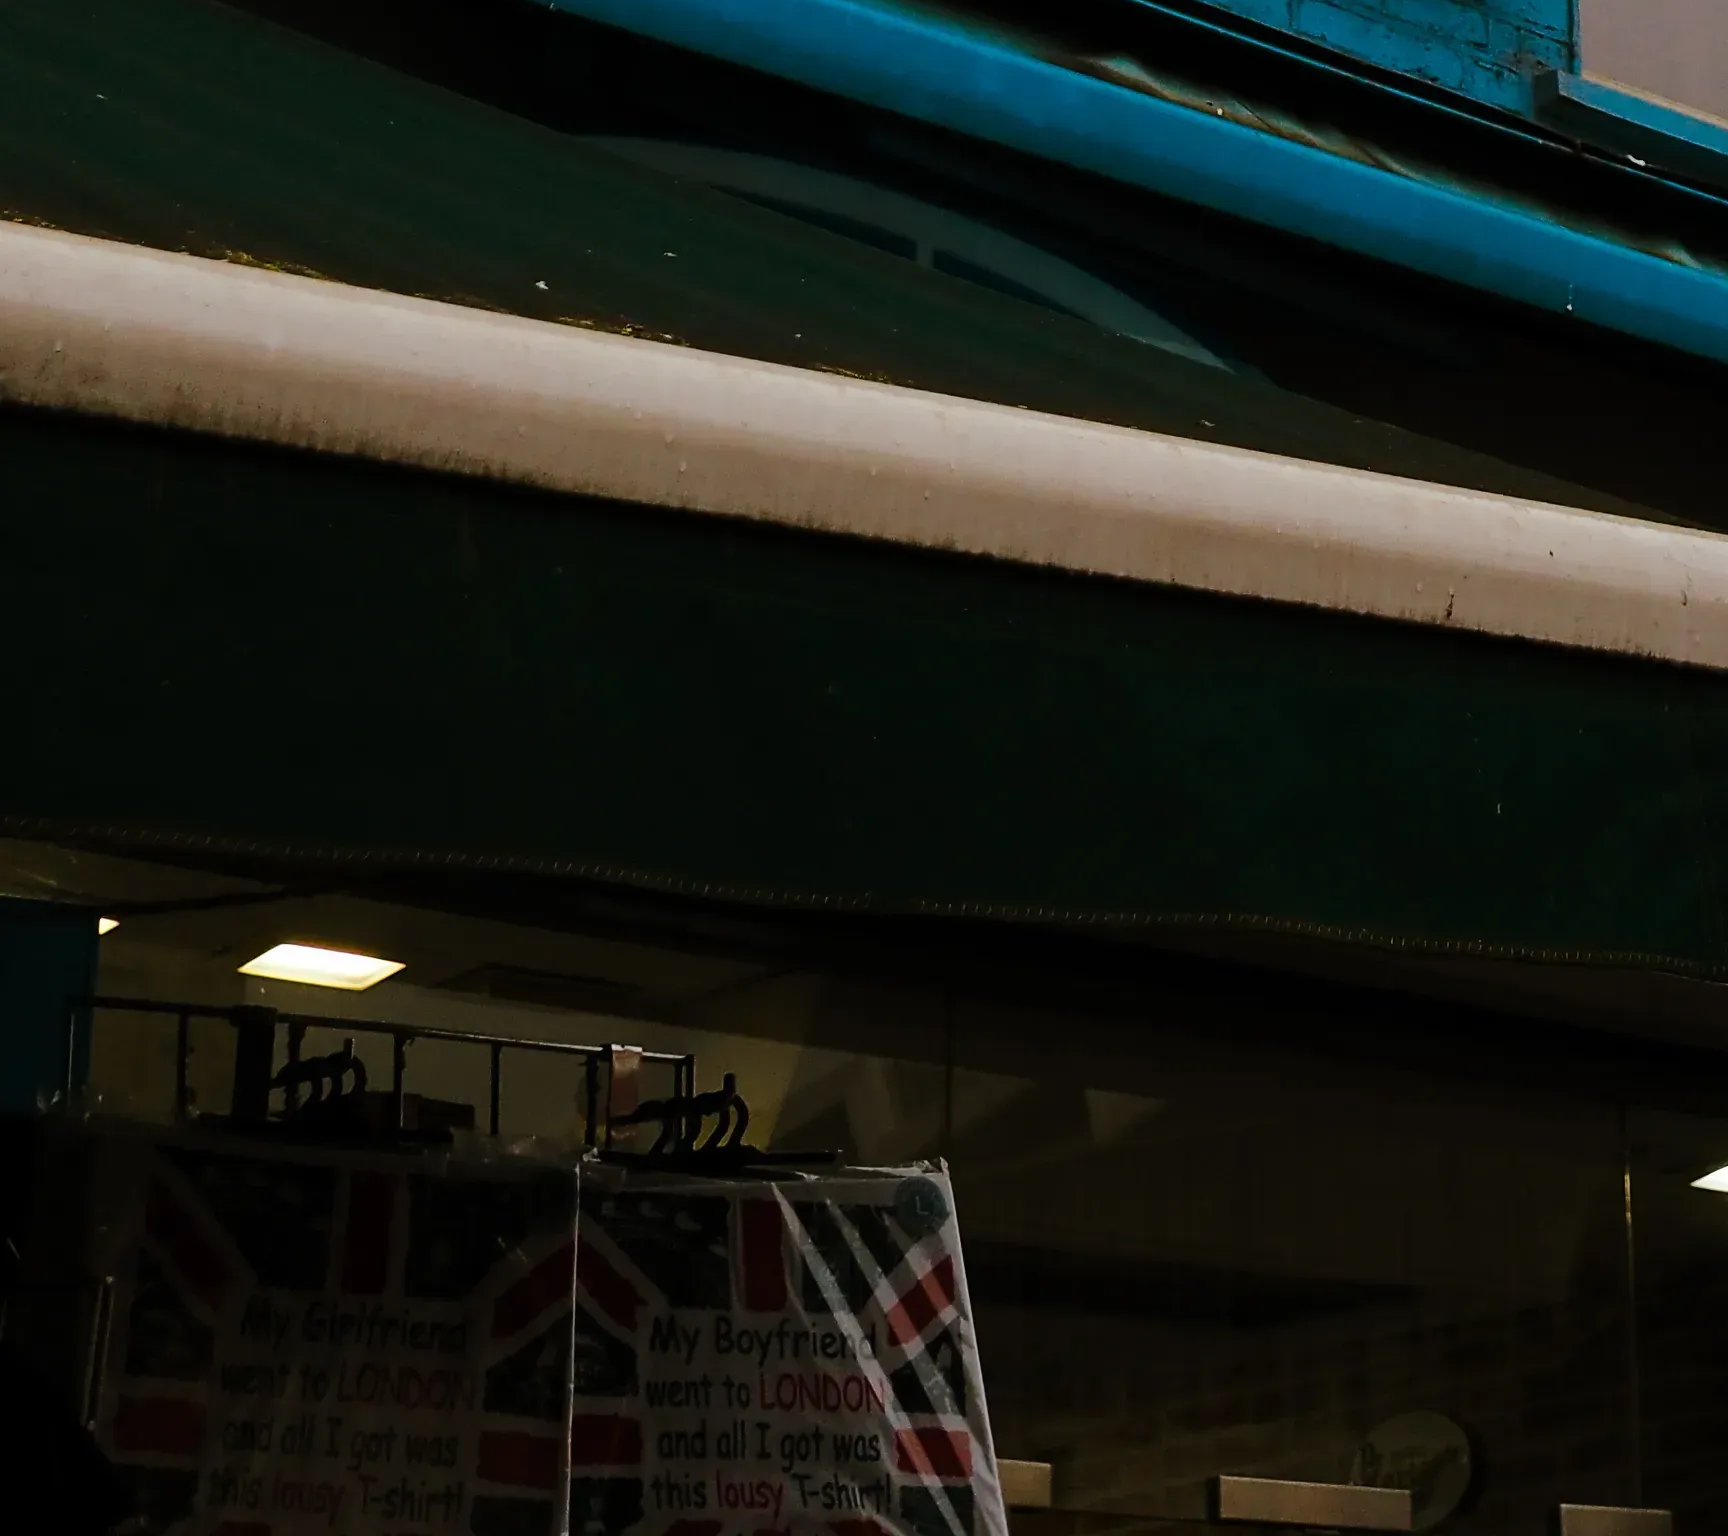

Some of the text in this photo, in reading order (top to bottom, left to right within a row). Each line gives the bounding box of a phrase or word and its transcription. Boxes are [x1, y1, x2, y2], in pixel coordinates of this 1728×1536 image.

[650, 1315, 878, 1367] My Boyfriend
[299, 1362, 329, 1402] to
[336, 1360, 476, 1411] LONDON
[647, 1372, 887, 1412] went to LONDON
[325, 1416, 343, 1458] I
[346, 1424, 399, 1471] got
[658, 1420, 881, 1473] and all I got was
[651, 1469, 892, 1520] this lousy T-shirt!
